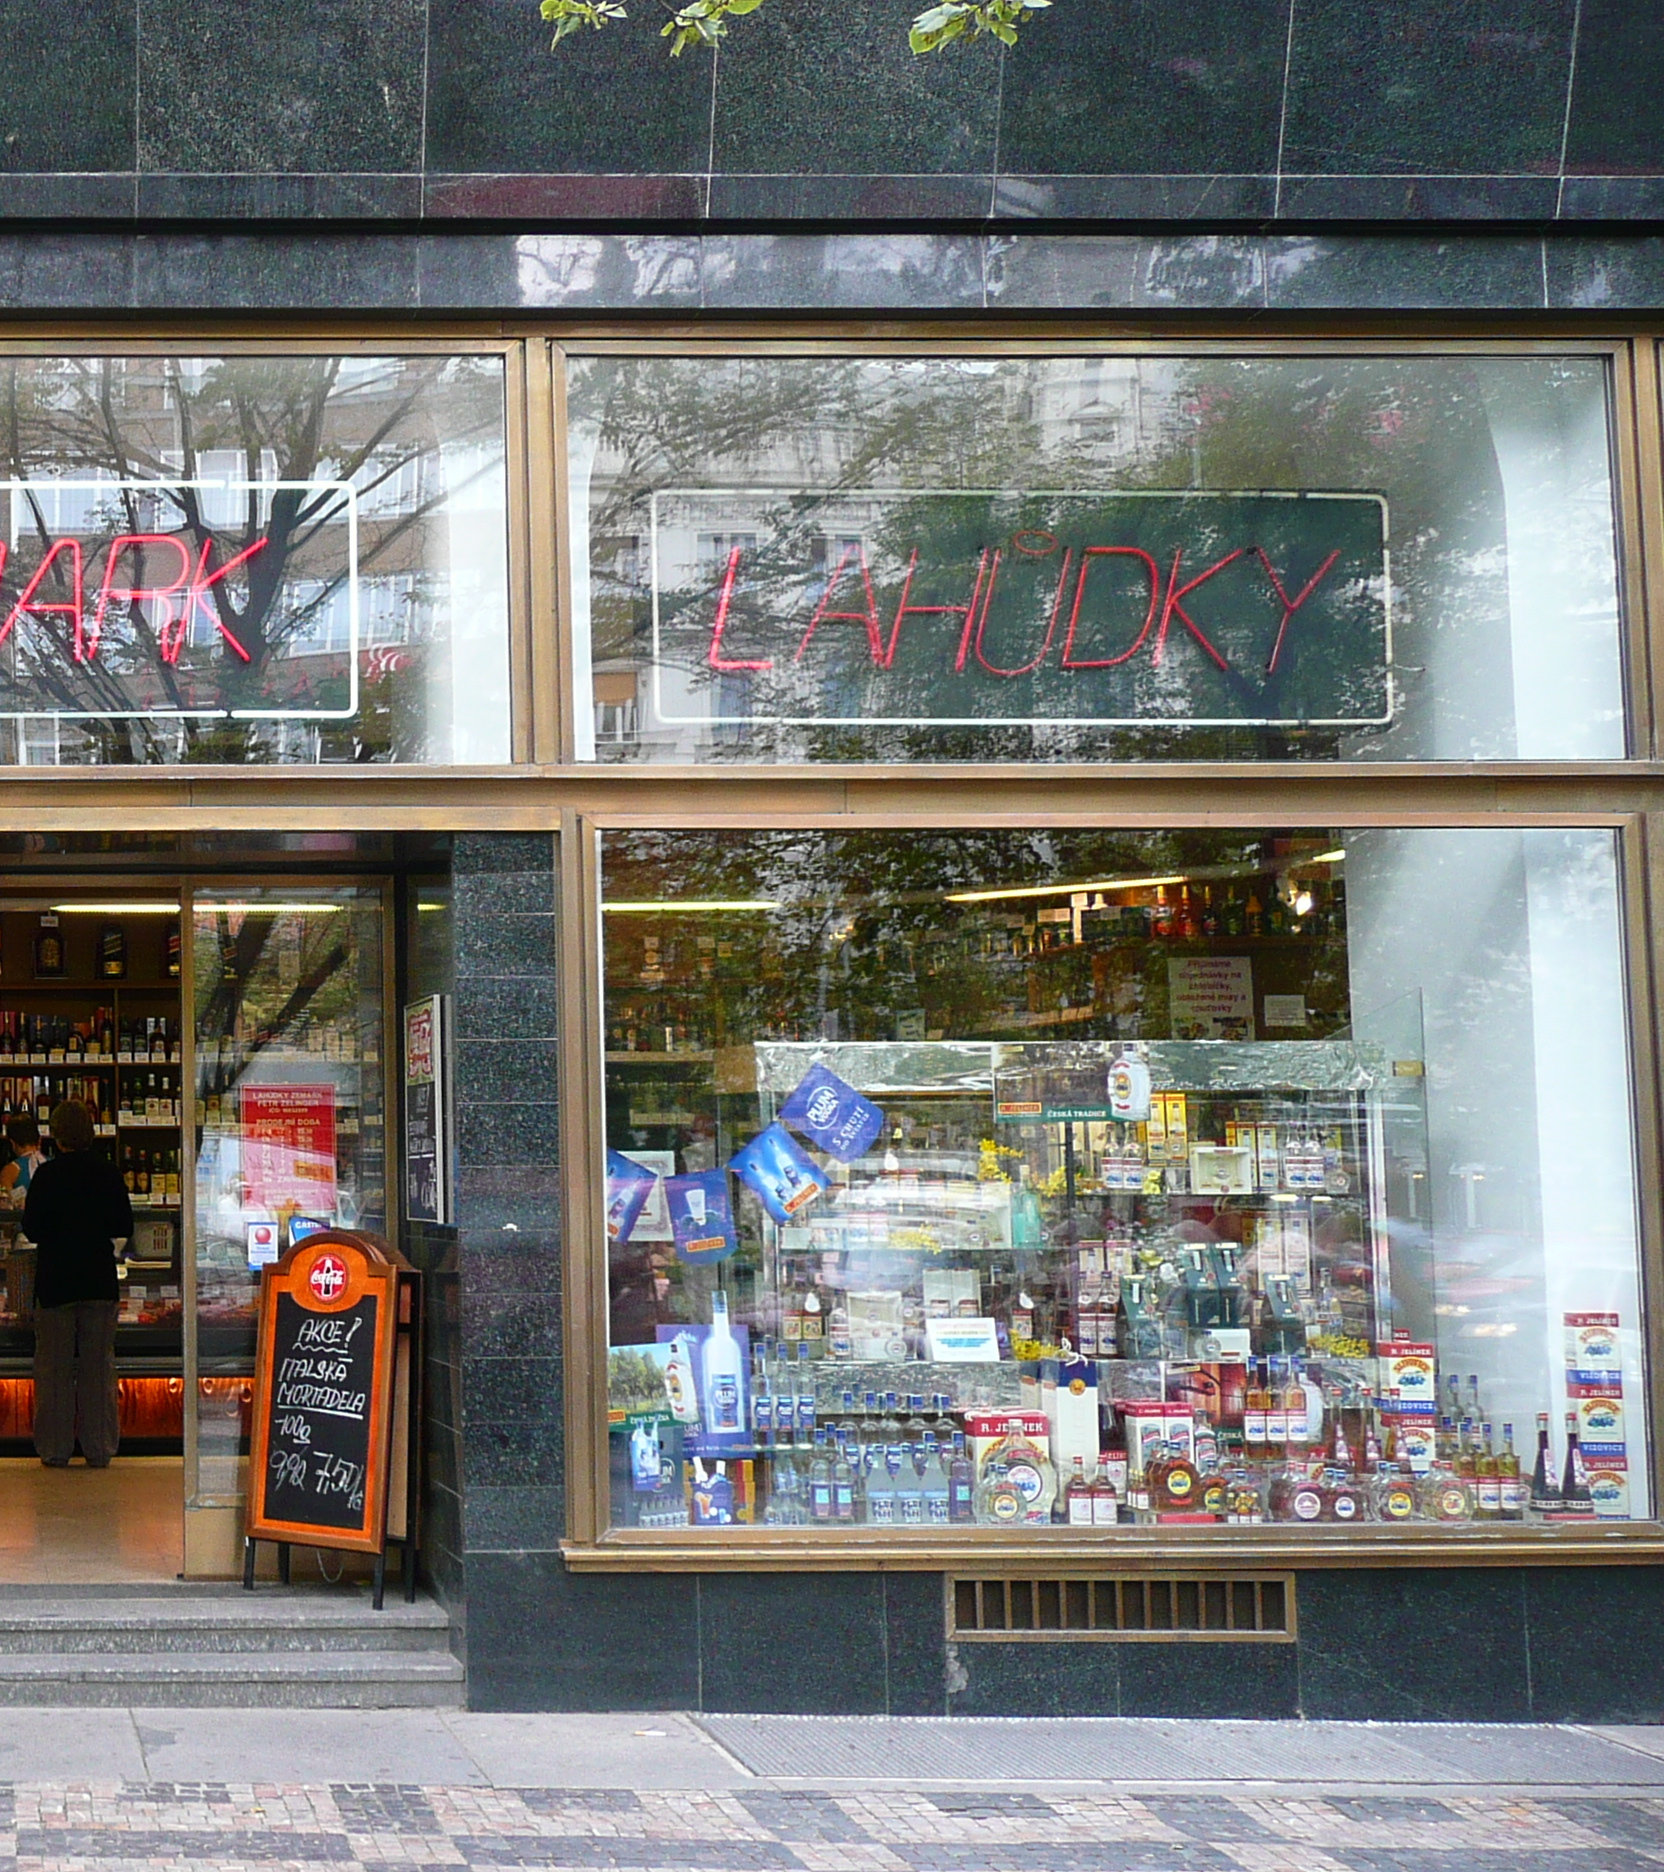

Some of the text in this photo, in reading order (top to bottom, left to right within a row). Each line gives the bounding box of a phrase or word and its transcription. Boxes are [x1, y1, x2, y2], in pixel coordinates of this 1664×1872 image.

[708, 530, 1341, 675] LAHŮDKY
[807, 1090, 835, 1122] PLUM
[277, 1382, 366, 1413] MORTADELA
[995, 1422, 1043, 1432] JENEK
